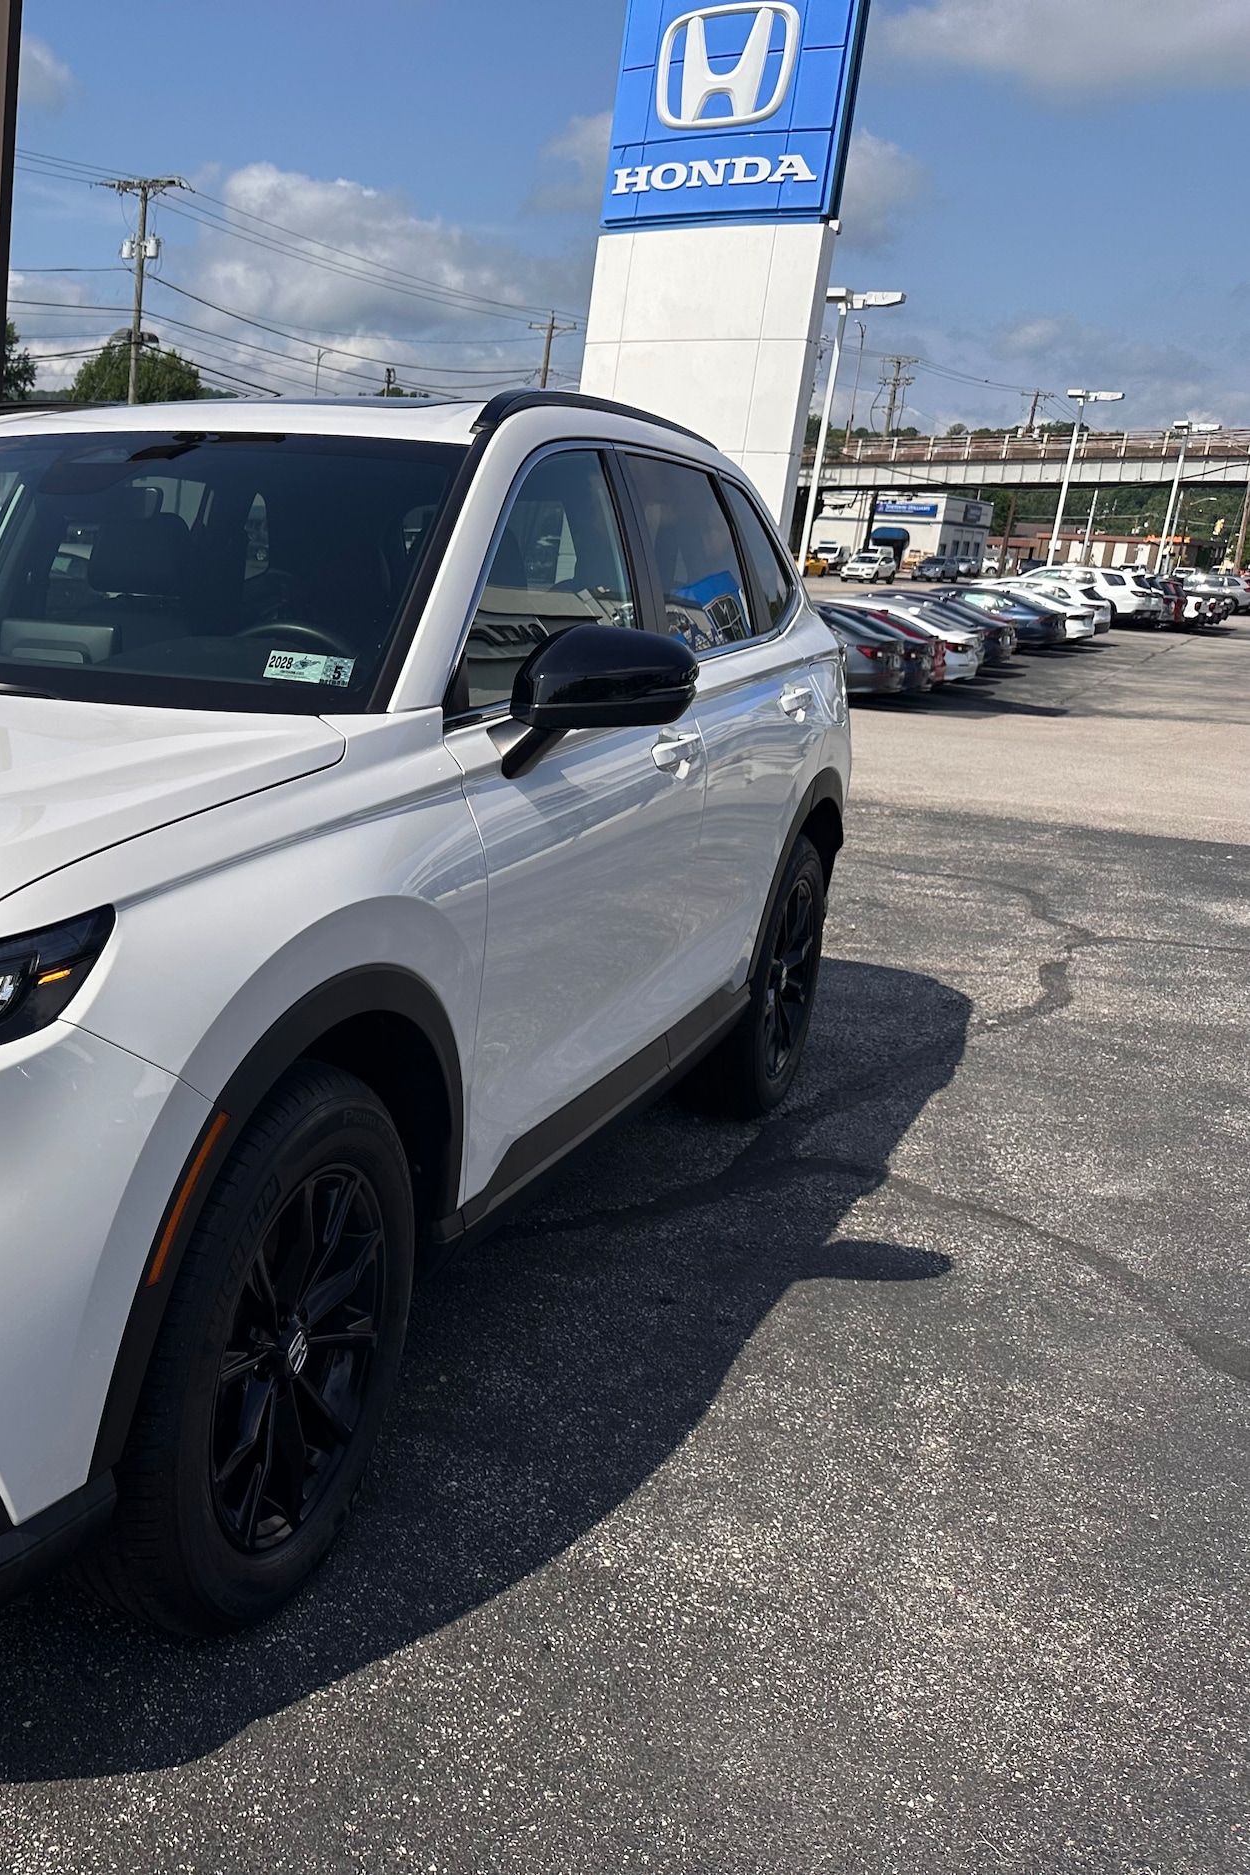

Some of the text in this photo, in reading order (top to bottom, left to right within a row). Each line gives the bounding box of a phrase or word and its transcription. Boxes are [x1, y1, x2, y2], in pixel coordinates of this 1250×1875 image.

[611, 154, 818, 195] HONDA
[268, 656, 294, 670] 2028
[332, 666, 344, 680] 5
[200, 1173, 282, 1346] MICHELIN
